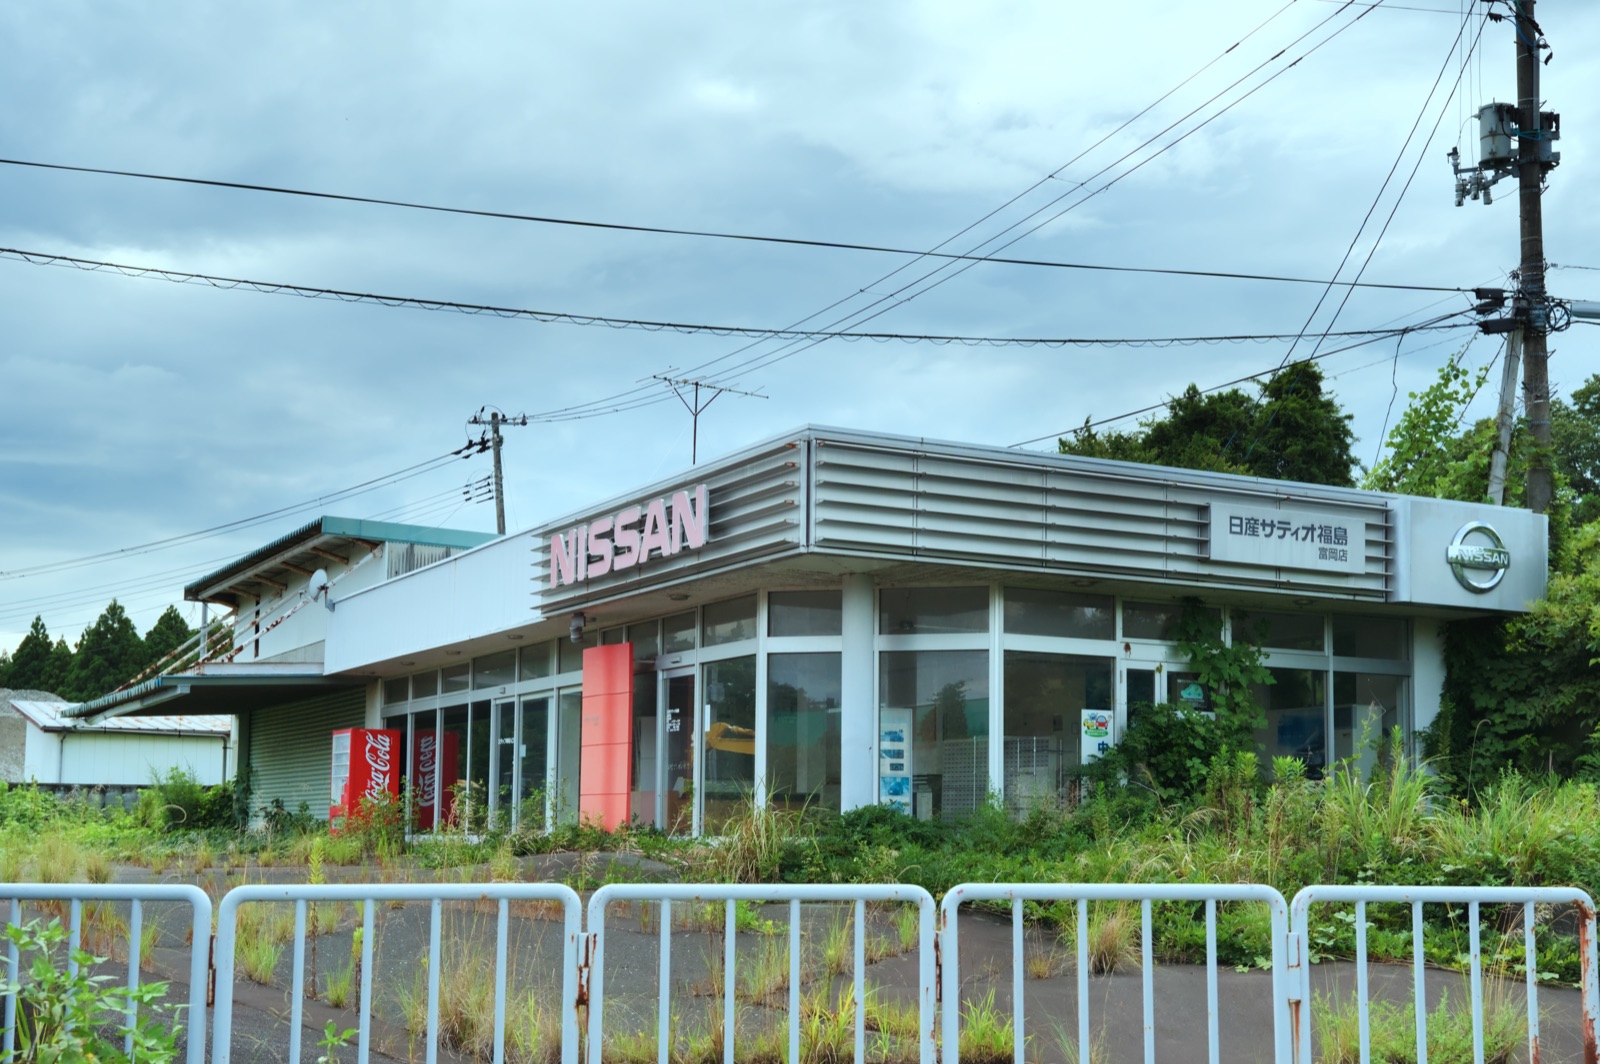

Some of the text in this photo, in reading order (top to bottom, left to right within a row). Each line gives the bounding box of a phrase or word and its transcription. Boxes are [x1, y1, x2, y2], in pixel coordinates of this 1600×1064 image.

[550, 483, 709, 589] NISSAN
[1229, 515, 1348, 546] 日産サティオ福島
[1318, 546, 1348, 563] 富岡店
[1458, 548, 1509, 565] NISSAN
[1097, 740, 1109, 755] 中
[365, 731, 391, 805] Coca-Cola
